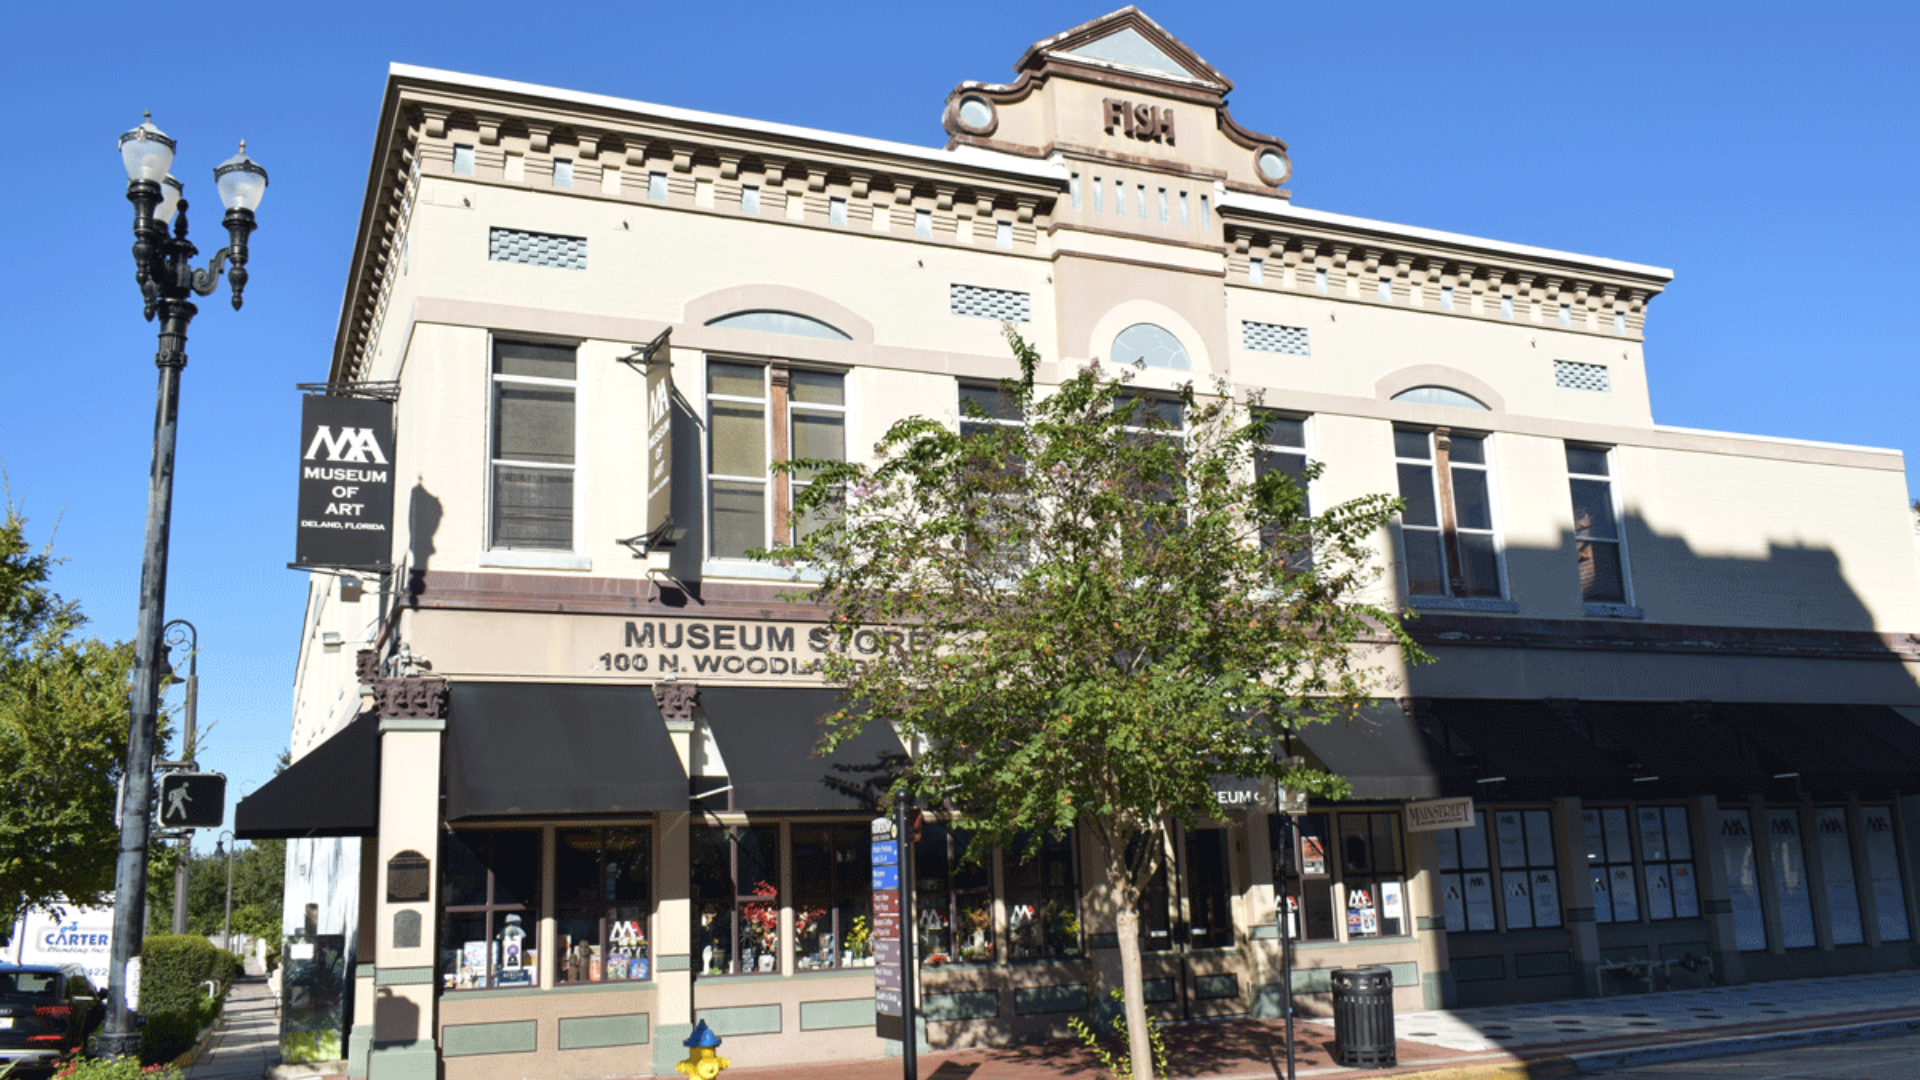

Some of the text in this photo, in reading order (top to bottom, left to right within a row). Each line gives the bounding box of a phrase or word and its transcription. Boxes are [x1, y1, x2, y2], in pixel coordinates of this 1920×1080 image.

[1102, 97, 1175, 147] FISH
[304, 467, 387, 483] MUSEUM
[332, 486, 359, 498] OF
[325, 503, 365, 516] ART
[301, 520, 386, 531] DELAND, FLORIDA
[625, 621, 794, 652] MUSEUM
[600, 652, 867, 676] 100 N. WOODLAD
[45, 934, 108, 945] CARTER
